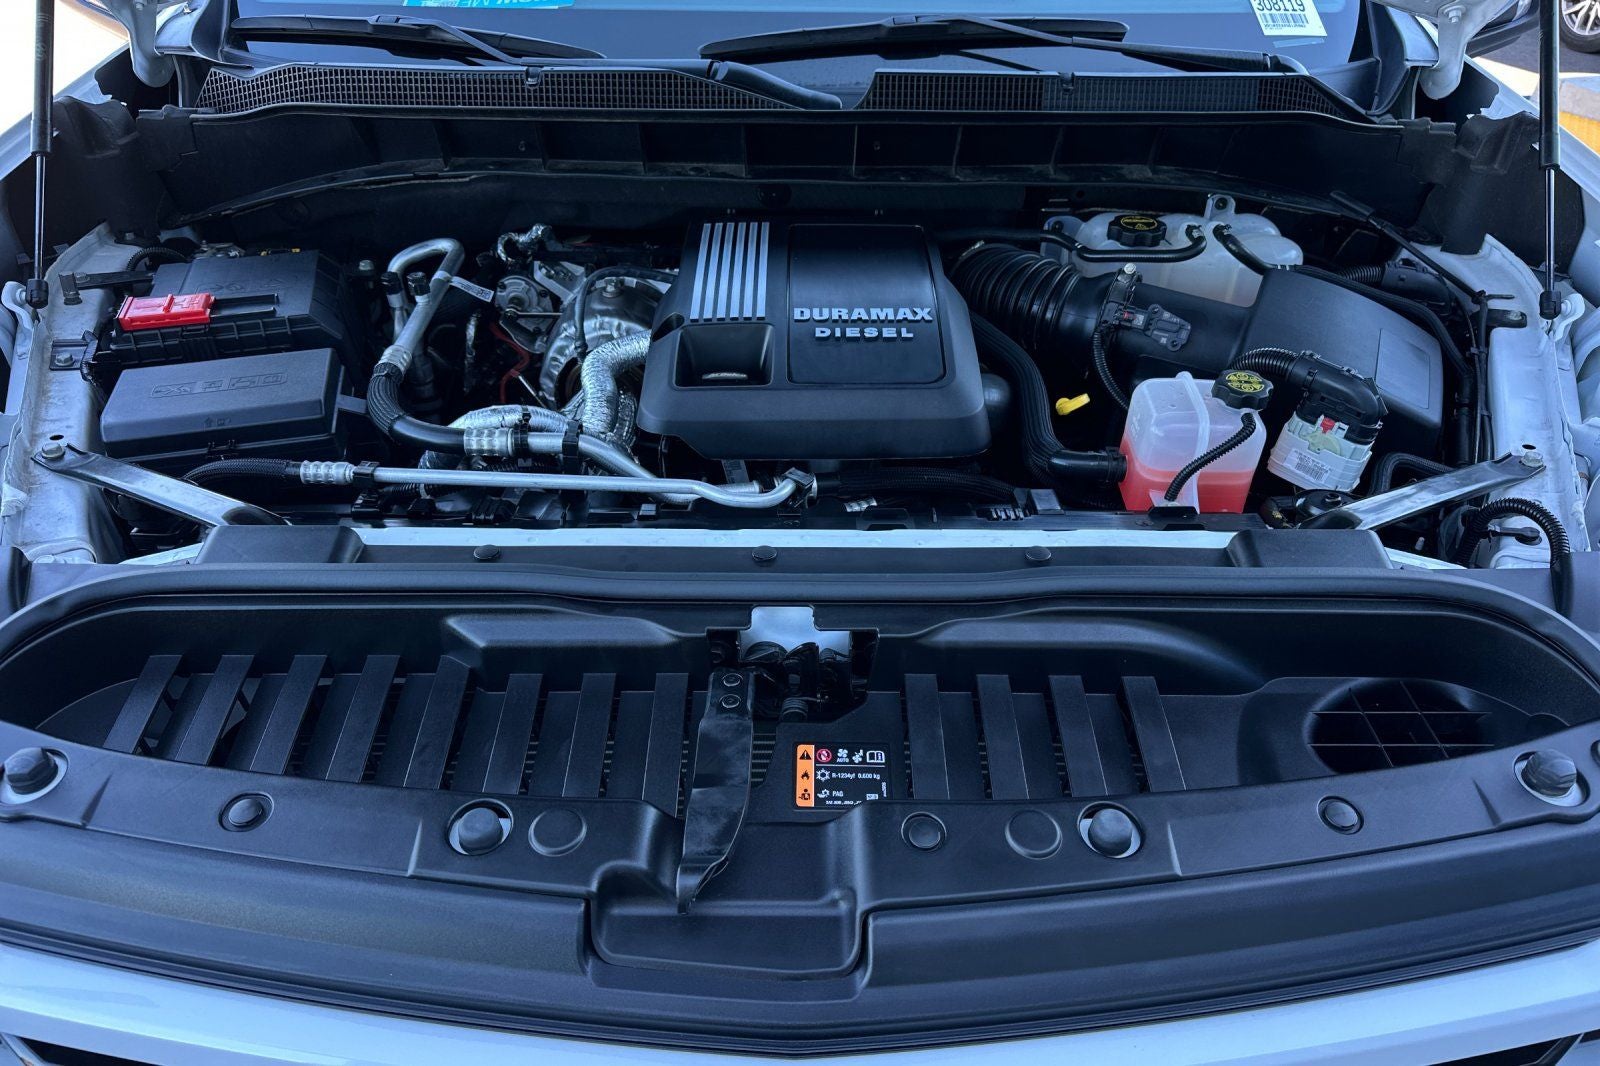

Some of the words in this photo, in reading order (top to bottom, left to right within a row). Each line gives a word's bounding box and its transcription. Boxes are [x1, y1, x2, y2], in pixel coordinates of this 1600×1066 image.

[1254, 0, 1306, 12] 308119
[793, 307, 933, 322] DURAMAX
[814, 327, 914, 340] DIESEL
